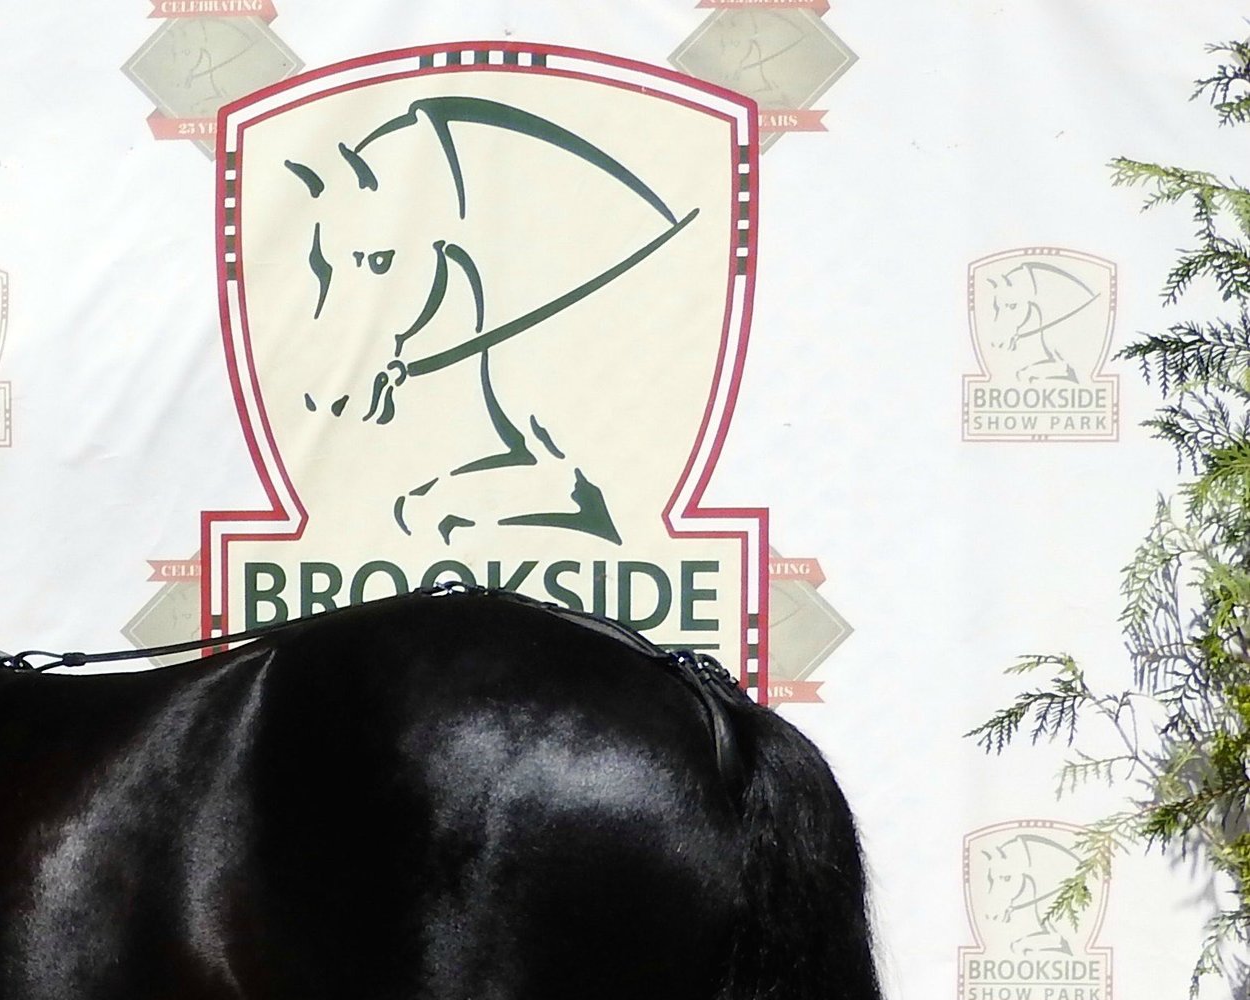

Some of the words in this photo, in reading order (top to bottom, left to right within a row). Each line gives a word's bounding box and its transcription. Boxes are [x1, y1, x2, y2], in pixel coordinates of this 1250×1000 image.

[161, 0, 263, 12] CELEBRATING
[178, 123, 196, 134] 25
[973, 388, 1107, 408] BROOKSIDE
[973, 416, 1038, 430] SHOW
[1050, 416, 1107, 430] PARK
[968, 959, 1100, 981] BROOKSIDE
